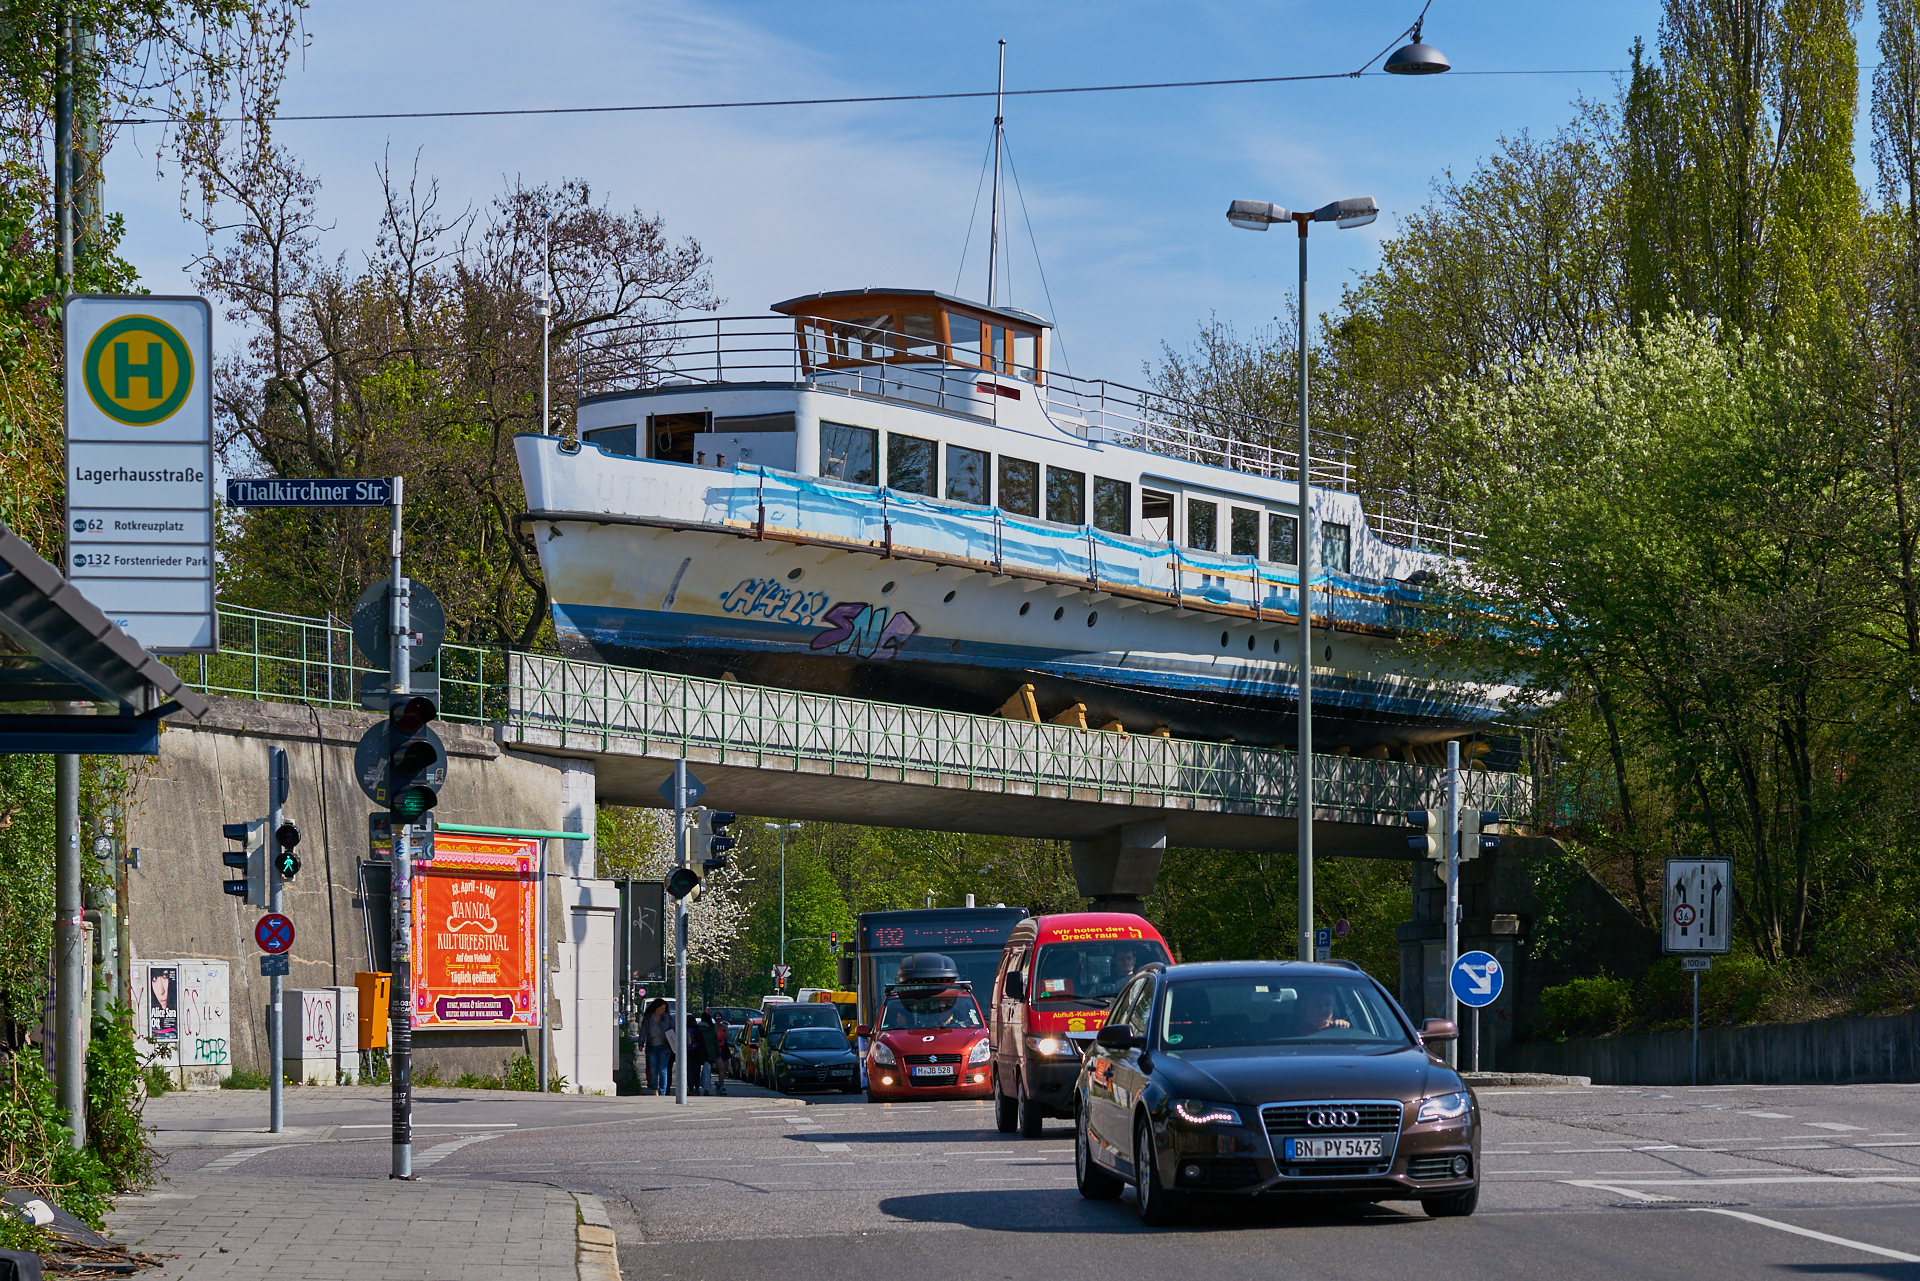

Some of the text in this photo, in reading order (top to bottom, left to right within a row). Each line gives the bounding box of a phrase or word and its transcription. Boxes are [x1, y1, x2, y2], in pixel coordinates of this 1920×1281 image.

[114, 342, 163, 400] H
[76, 467, 204, 485] Lagerhausstraße
[234, 482, 384, 501] Thalkirchner Str.
[88, 519, 103, 530] 62
[114, 520, 184, 533] Rotkreuzplatz
[88, 554, 110, 565] 132
[114, 555, 182, 567] Forstenrieder
[185, 556, 208, 567] Park
[461, 879, 476, 895] April
[451, 900, 491, 920] WANNDA
[437, 933, 510, 952] KULTURFESTIVAL
[875, 927, 904, 946] 132
[1061, 933, 1092, 941] Dreck
[450, 970, 497, 986] Täglich geöffnet
[151, 1006, 177, 1018] Alice Sara
[151, 1017, 161, 1028] Ott
[927, 1066, 937, 1074] JB
[937, 1066, 951, 1074] 528
[1295, 1140, 1313, 1157] BN
[1324, 1140, 1342, 1156] PY
[1346, 1140, 1381, 1156] 5473
